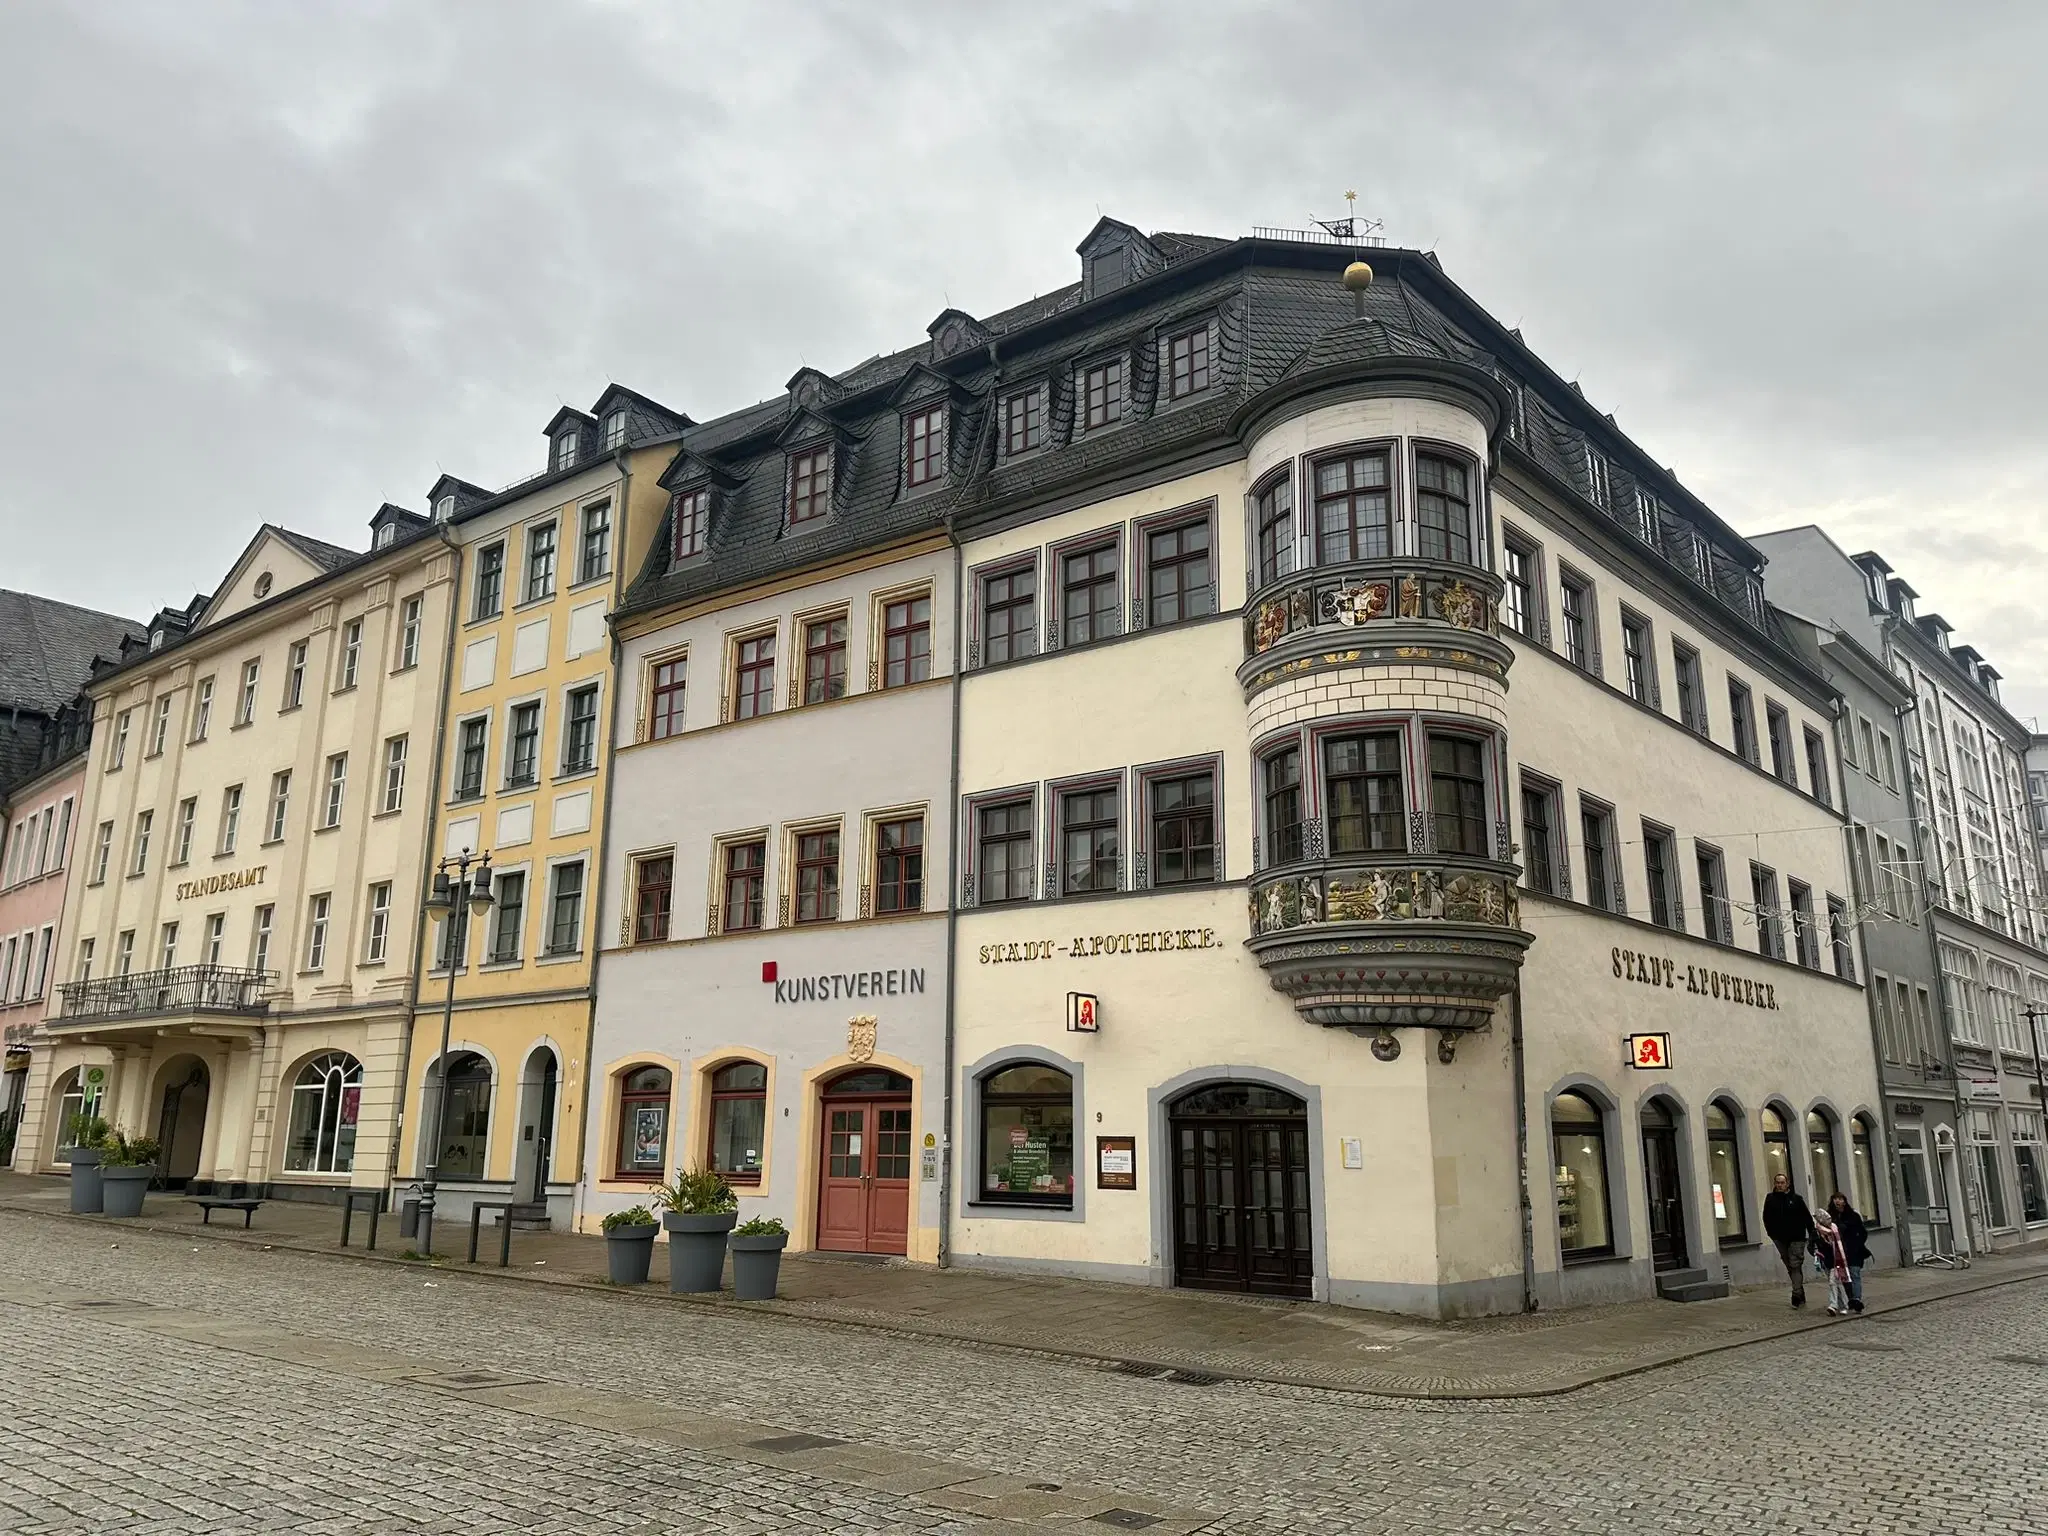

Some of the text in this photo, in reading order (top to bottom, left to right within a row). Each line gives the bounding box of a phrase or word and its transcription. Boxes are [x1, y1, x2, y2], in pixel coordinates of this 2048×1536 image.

[176, 865, 268, 901] STANDESAMT
[775, 967, 925, 1004] KUNSTVEREIN
[784, 1107, 790, 1118] 8
[1096, 1111, 1103, 1123] 9
[1024, 1141, 1047, 1149] Husten
